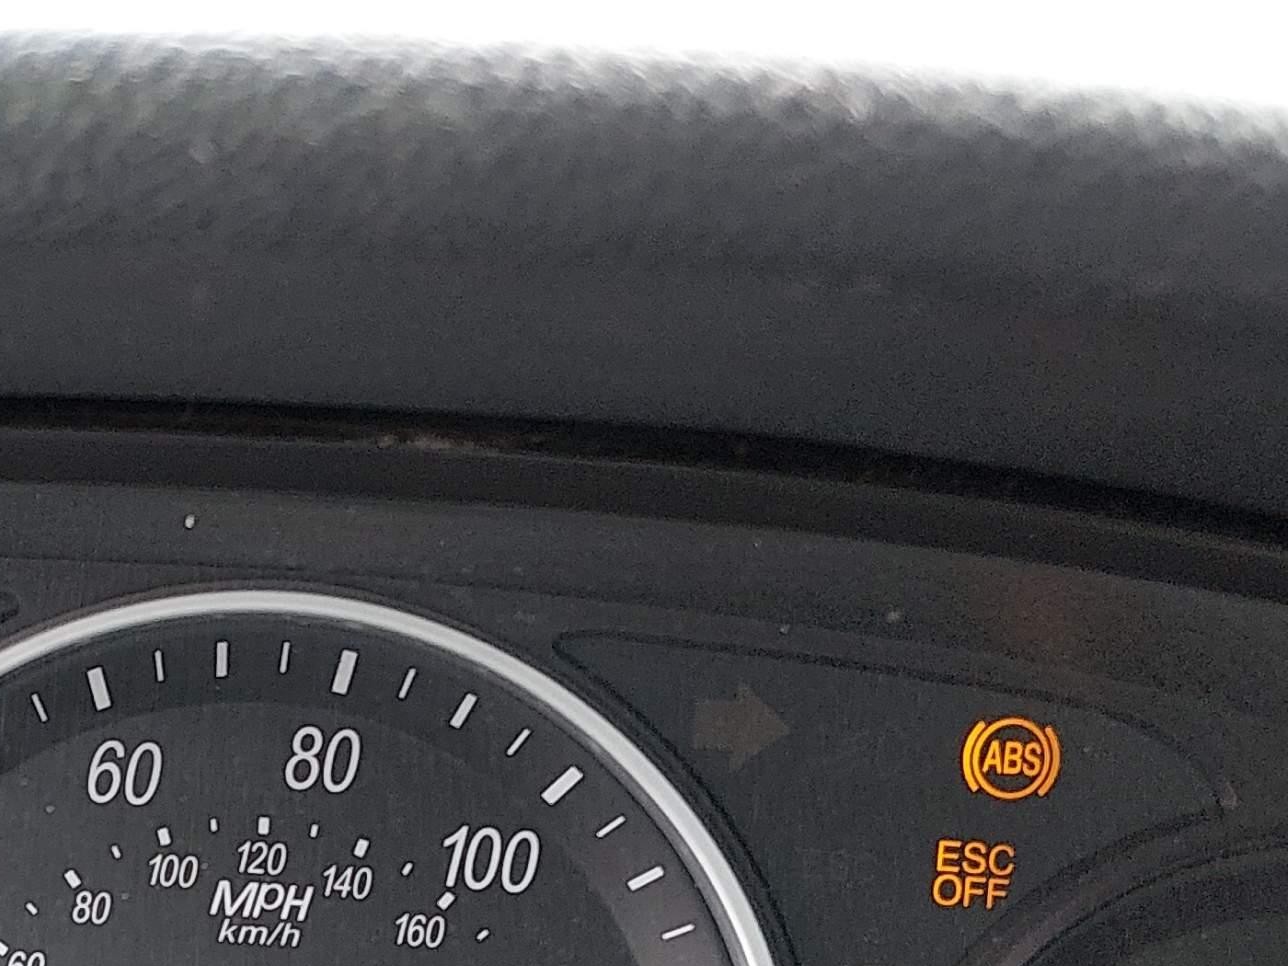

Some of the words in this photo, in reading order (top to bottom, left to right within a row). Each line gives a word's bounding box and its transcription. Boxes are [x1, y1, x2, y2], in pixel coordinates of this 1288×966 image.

[86, 739, 164, 806] 60
[283, 726, 361, 793] 80
[982, 739, 1043, 777] ABS
[148, 853, 199, 889] 100
[236, 841, 287, 876] 120
[441, 824, 540, 893] 100
[935, 839, 1015, 876] ESC
[210, 879, 314, 922] MPH
[322, 865, 372, 900] 140
[932, 873, 1010, 910] OFF
[72, 891, 111, 925] 80
[217, 922, 302, 949] km/h
[394, 913, 445, 949] 160
